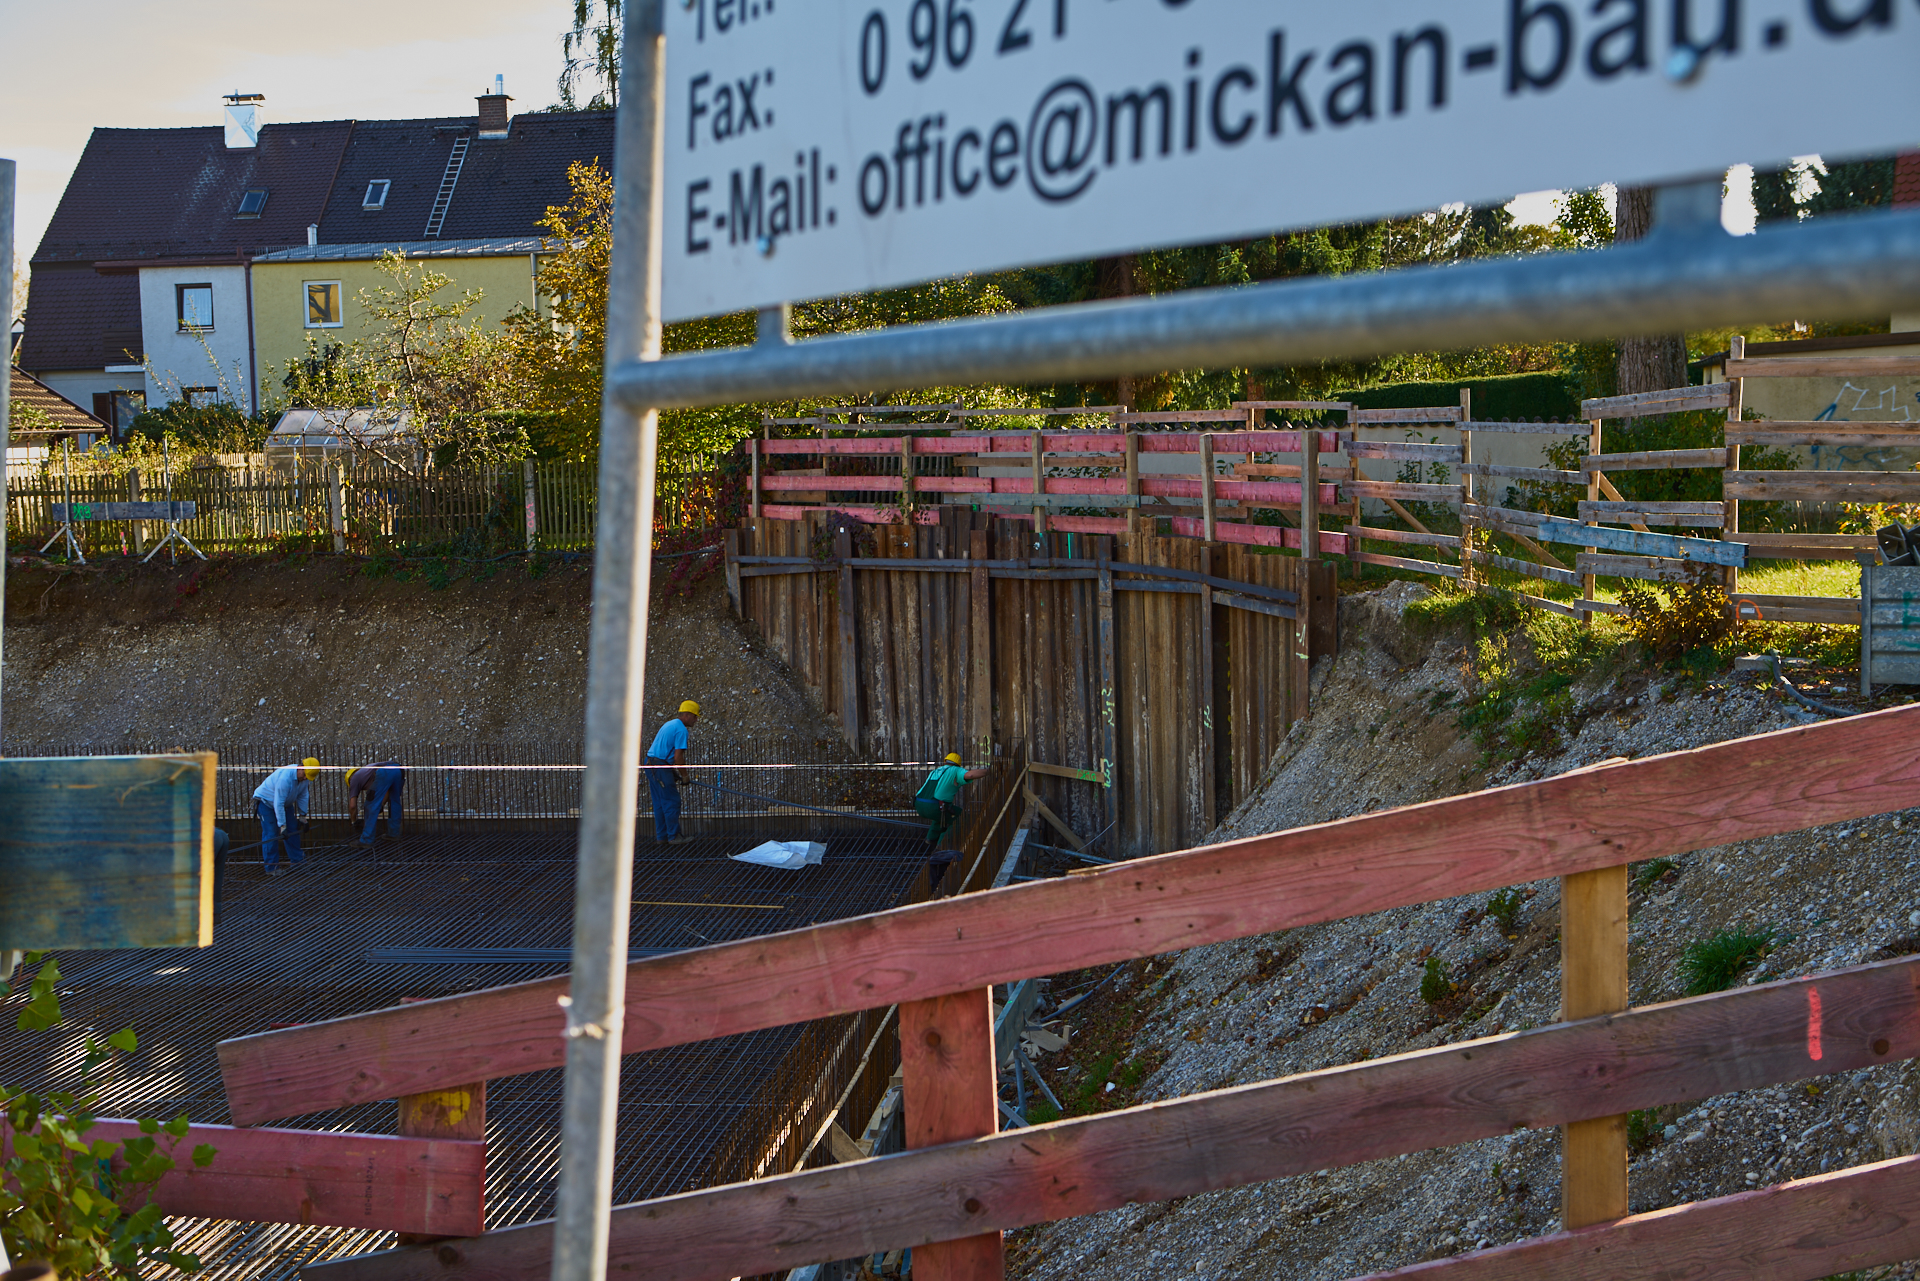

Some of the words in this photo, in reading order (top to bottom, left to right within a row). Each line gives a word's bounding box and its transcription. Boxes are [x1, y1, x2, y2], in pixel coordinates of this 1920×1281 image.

[687, 69, 774, 151] Fax:
[858, 9, 889, 97] 0
[908, 0, 976, 83] 96
[696, 0, 774, 43] Te.
[686, 147, 837, 257] E-Mail:
[858, 0, 1920, 218] office@mickan-bau.
